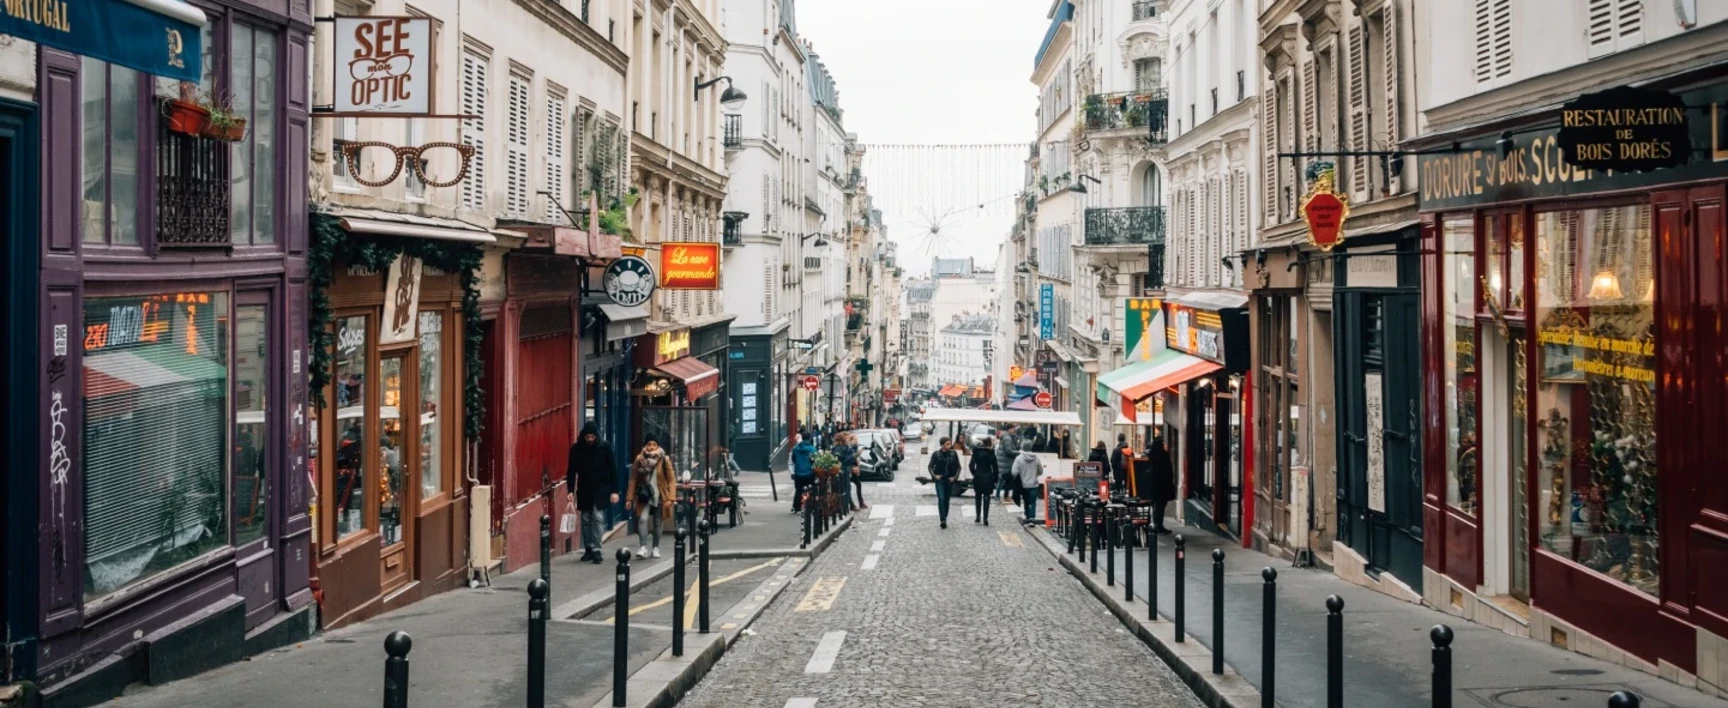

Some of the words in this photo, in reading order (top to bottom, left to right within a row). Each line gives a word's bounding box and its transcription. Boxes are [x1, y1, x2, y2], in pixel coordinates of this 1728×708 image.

[0, 0, 70, 33] ORTUGAL
[354, 18, 411, 58] SEE
[367, 62, 393, 73] mon
[351, 73, 412, 106] OPTIC
[1563, 107, 1684, 128] RESTAURATION
[1615, 129, 1634, 140] DE
[1576, 143, 1613, 161] BOIS
[1619, 138, 1672, 160] DORÉS
[1423, 150, 1484, 202] DORURE
[1311, 204, 1338, 212] doreur
[1316, 221, 1334, 229] bois
[670, 246, 688, 264] La
[689, 255, 709, 264] cave
[662, 266, 715, 285] gourmande
[1130, 298, 1161, 309] BAR
[1600, 338, 1610, 350] en
[1611, 335, 1642, 355] marche
[1643, 338, 1655, 356] de
